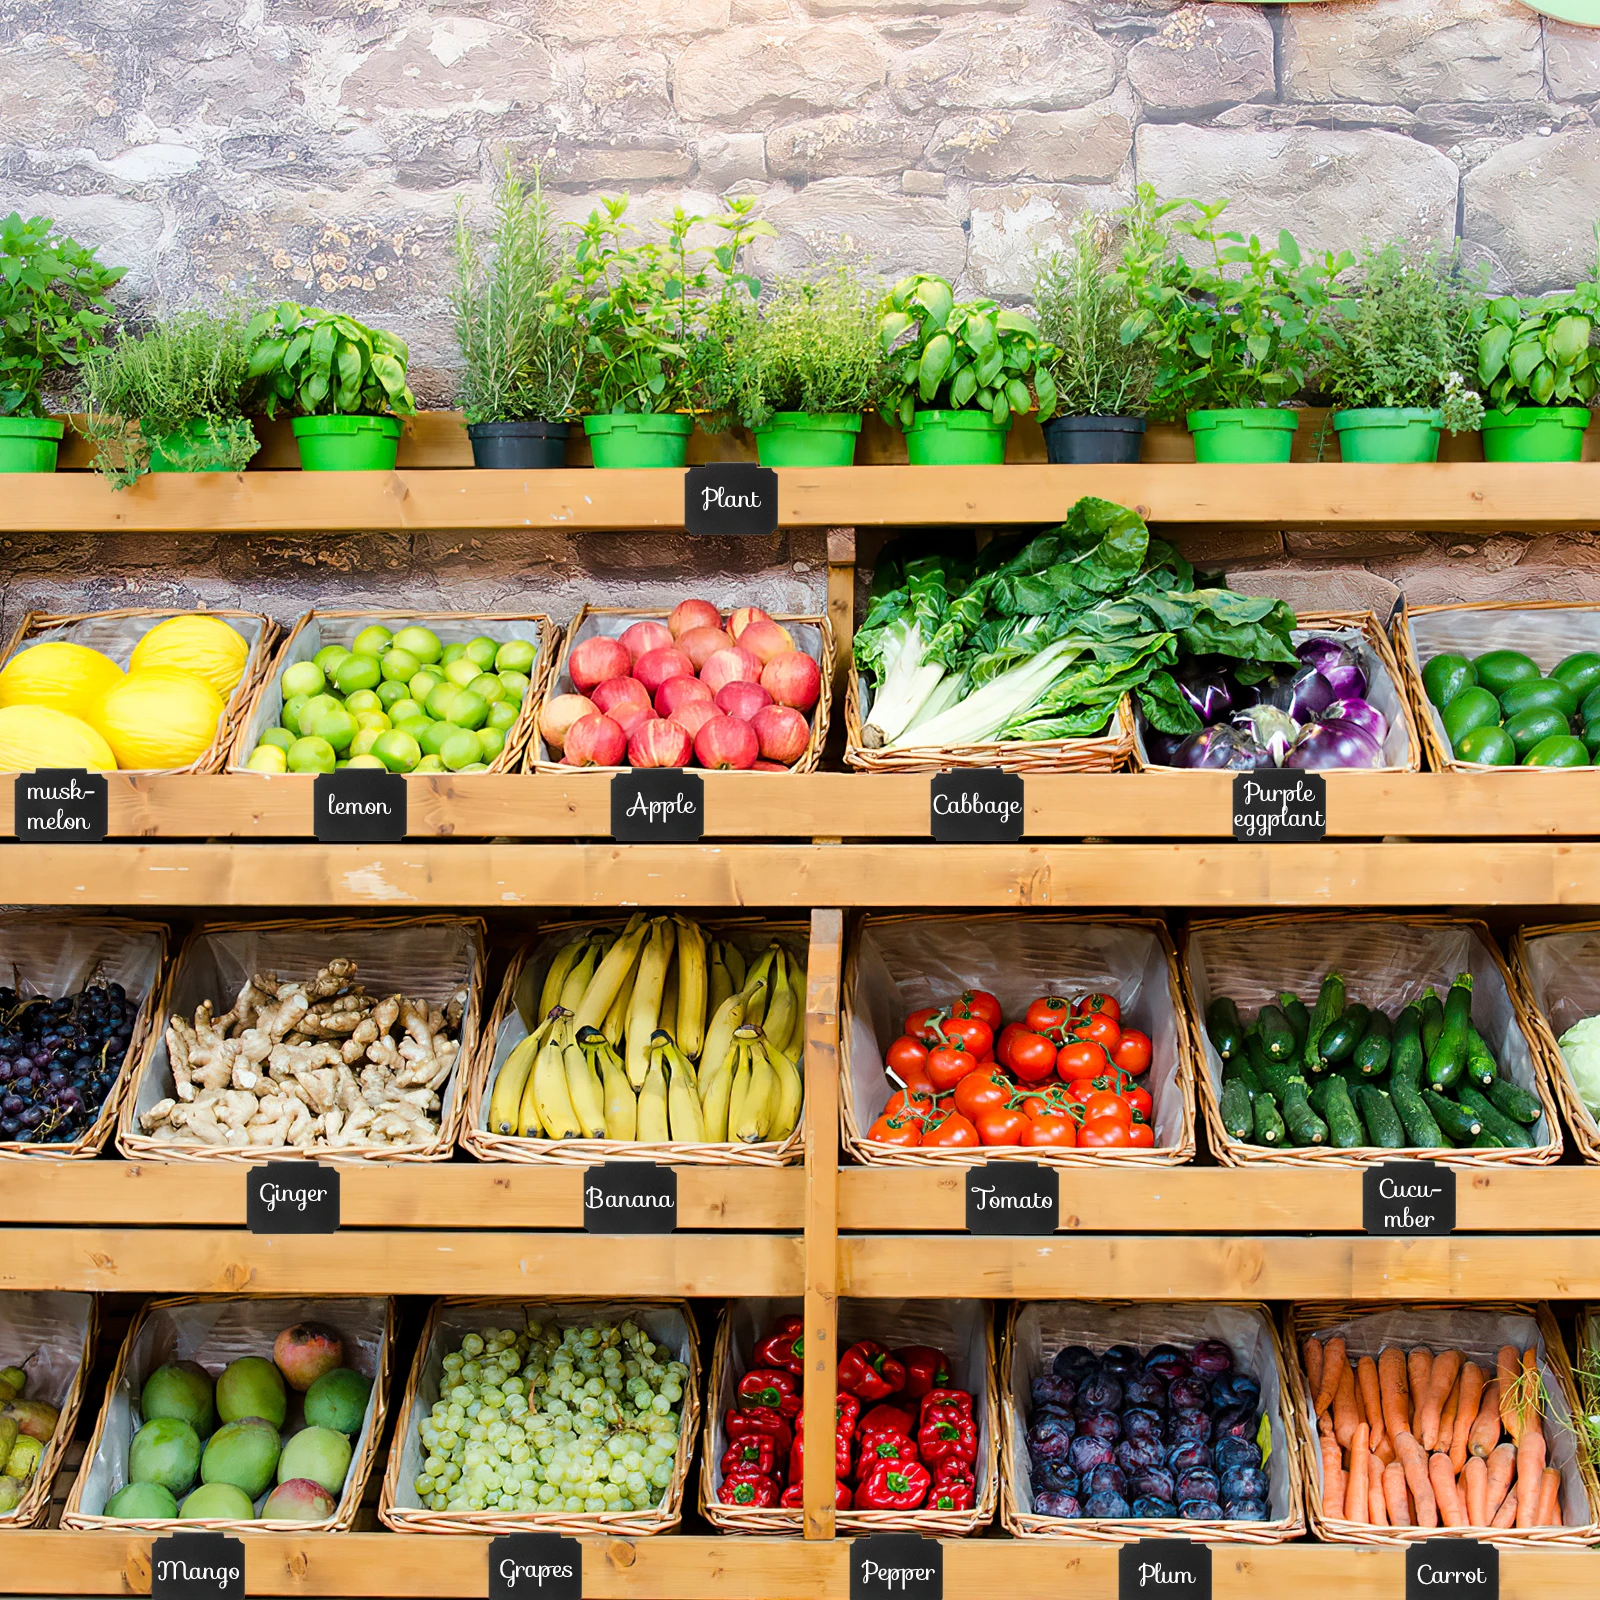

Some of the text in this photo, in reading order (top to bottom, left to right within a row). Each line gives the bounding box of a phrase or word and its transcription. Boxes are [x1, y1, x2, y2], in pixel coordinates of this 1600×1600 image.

[701, 486, 761, 511] Plant
[28, 778, 95, 799] musk-
[1243, 780, 1315, 808] Purple
[329, 793, 391, 814] lemon
[626, 792, 696, 823] Apple
[933, 793, 1022, 823] Cabbage
[28, 808, 90, 829] melon
[1234, 804, 1325, 835] eggplant
[260, 1183, 327, 1211] Ginger
[585, 1186, 675, 1210] Banana
[971, 1185, 1052, 1210] Tomato
[1379, 1178, 1442, 1199] Cucu-
[1385, 1207, 1435, 1227] mber
[158, 1561, 239, 1589] Mango
[500, 1559, 572, 1587] Grapes
[861, 1560, 935, 1590] Pepper
[1138, 1562, 1196, 1587] Plum
[1417, 1564, 1487, 1585] Carrot
